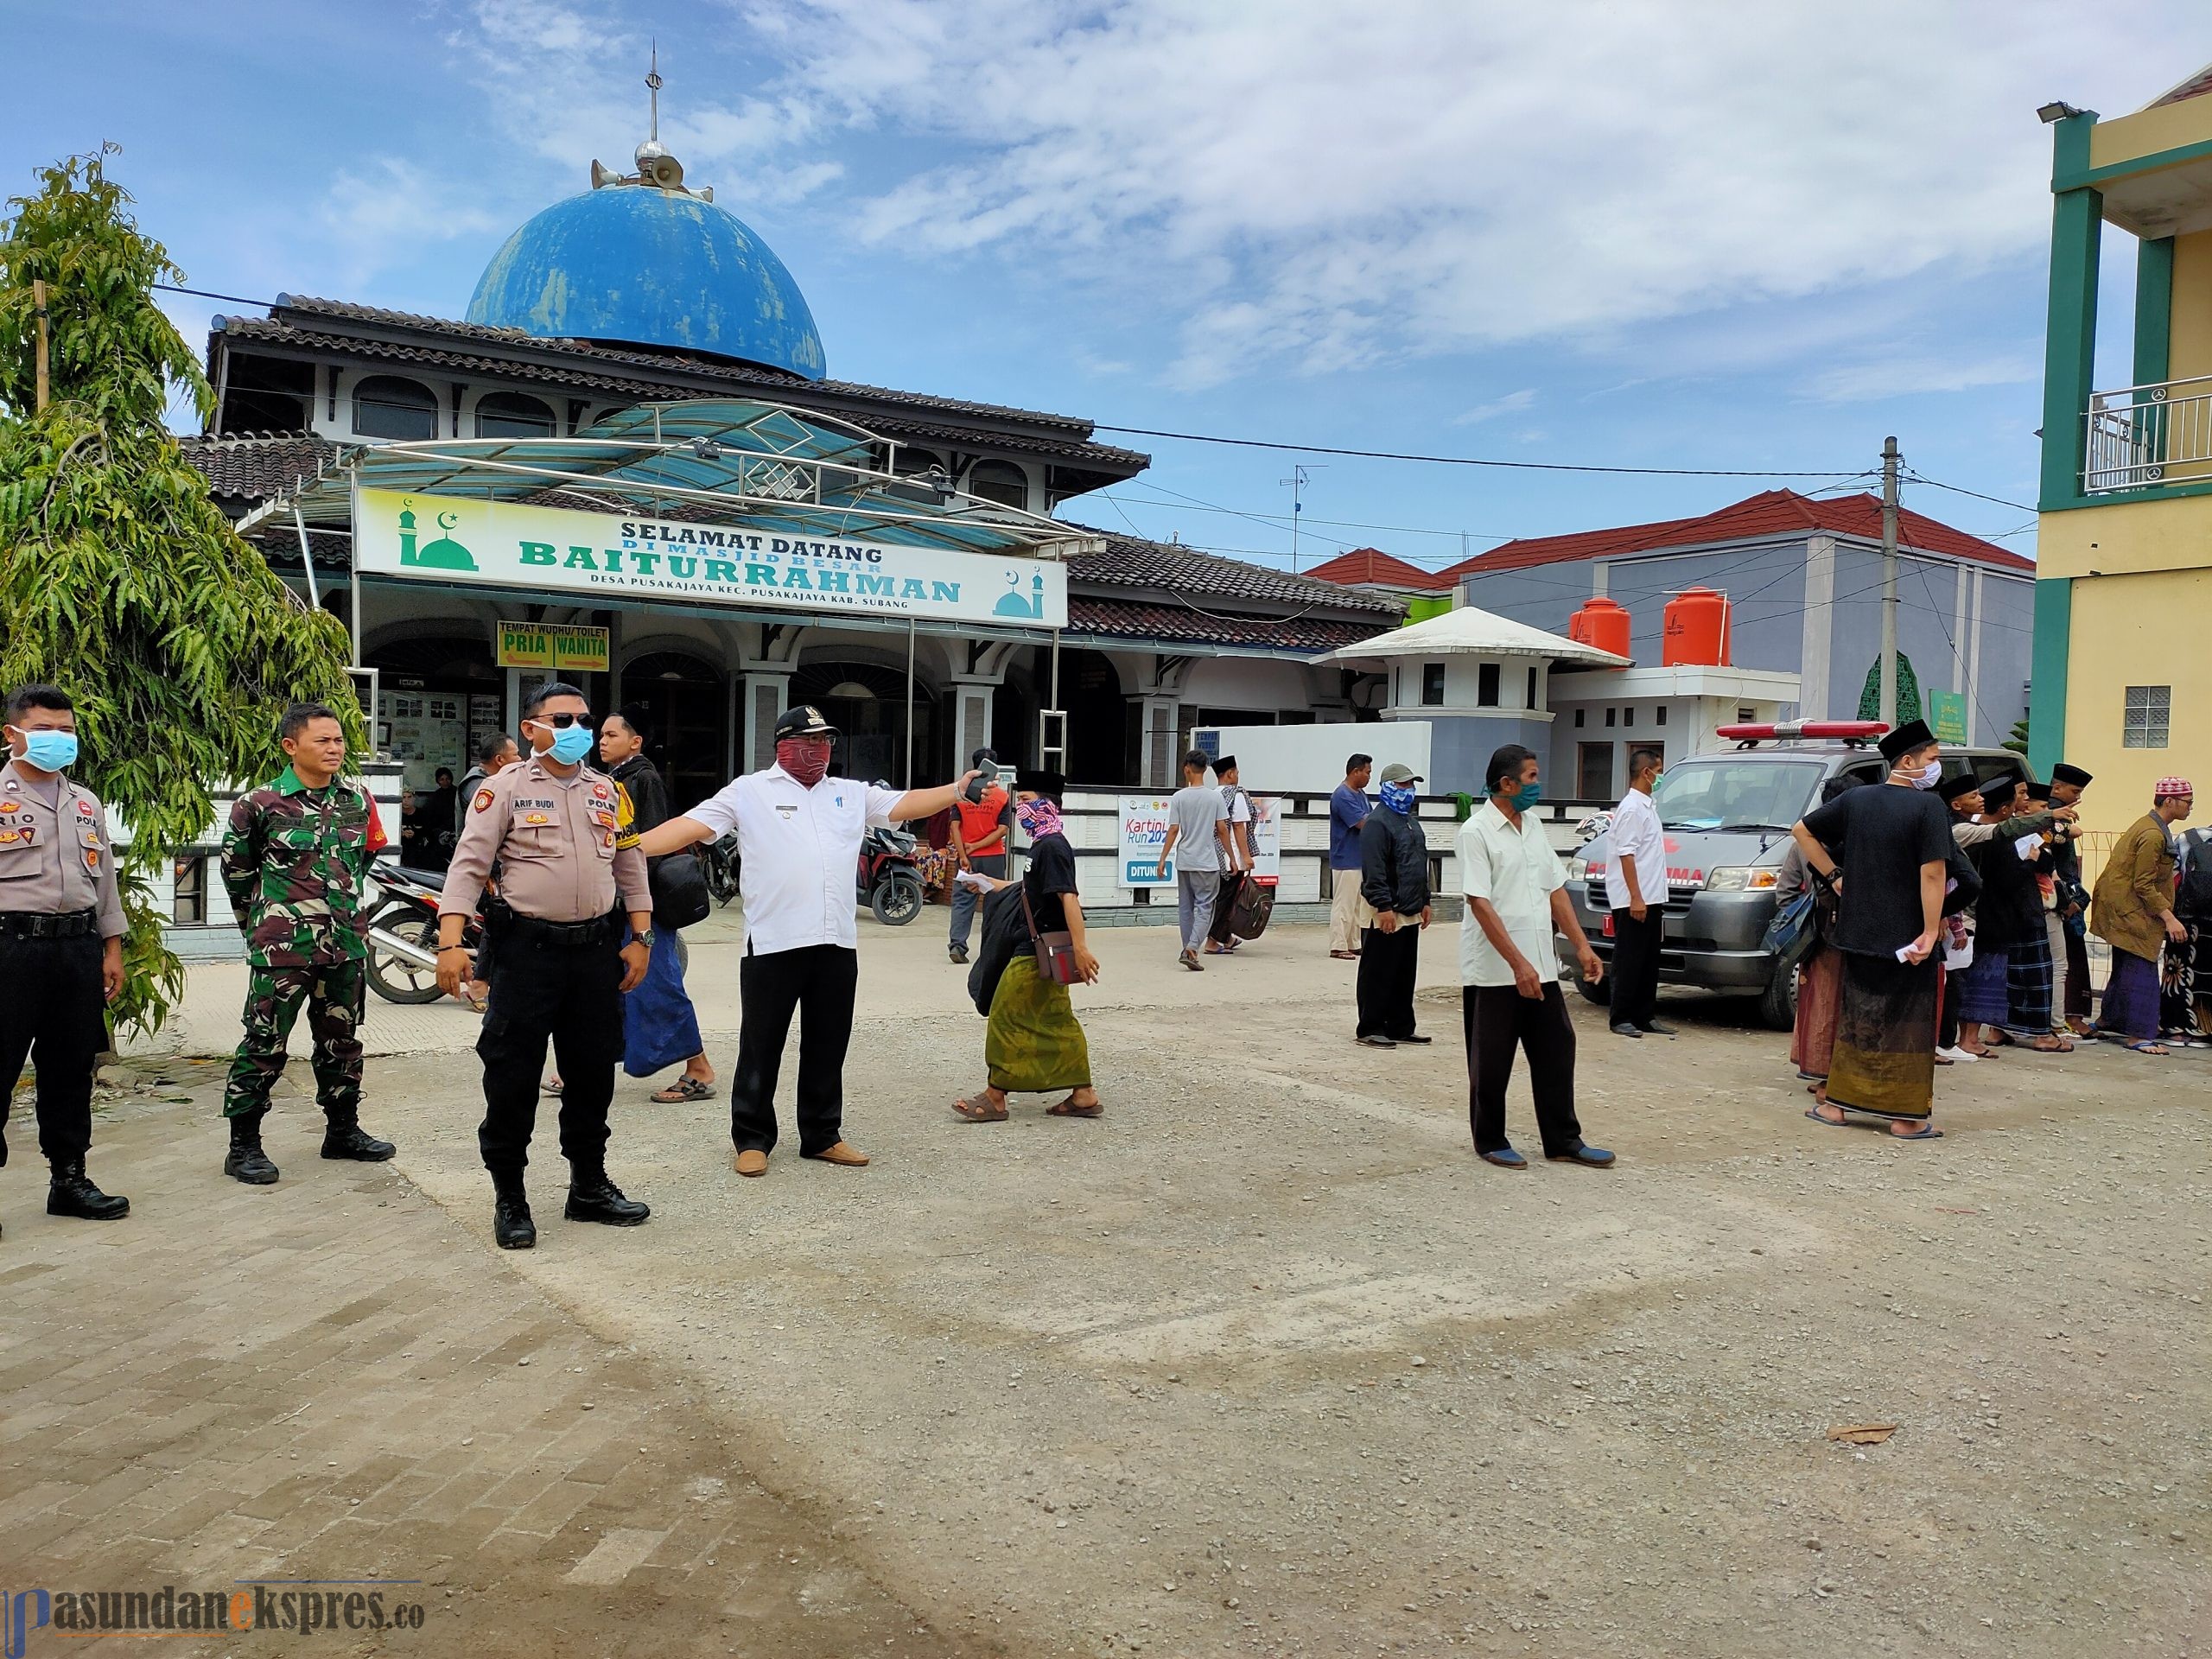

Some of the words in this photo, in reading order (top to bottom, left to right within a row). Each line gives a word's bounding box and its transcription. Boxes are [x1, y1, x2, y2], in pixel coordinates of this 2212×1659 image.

[621, 522, 762, 550] SELAMAT
[772, 538, 882, 563] DATANG
[668, 543, 779, 563] MASJID
[792, 556, 881, 573] BESAR
[518, 541, 961, 603] BAITURRAHMAN
[590, 575, 625, 585] DESA
[631, 577, 712, 592] PUSAKAJAYA
[718, 585, 745, 595] KEC.
[752, 588, 826, 602] PUSAKAJAYA
[831, 595, 857, 605] KAB.
[862, 598, 908, 609] SUBANG
[500, 622, 535, 633] TEMPAT
[537, 625, 607, 637] WUDHU/TOILET
[504, 633, 546, 653] PRIA
[556, 636, 607, 657] WANITA
[514, 799, 533, 809] ARIF
[536, 799, 554, 809] BUDI
[1126, 818, 1167, 833] Kartini
[1128, 830, 1147, 843] Run
